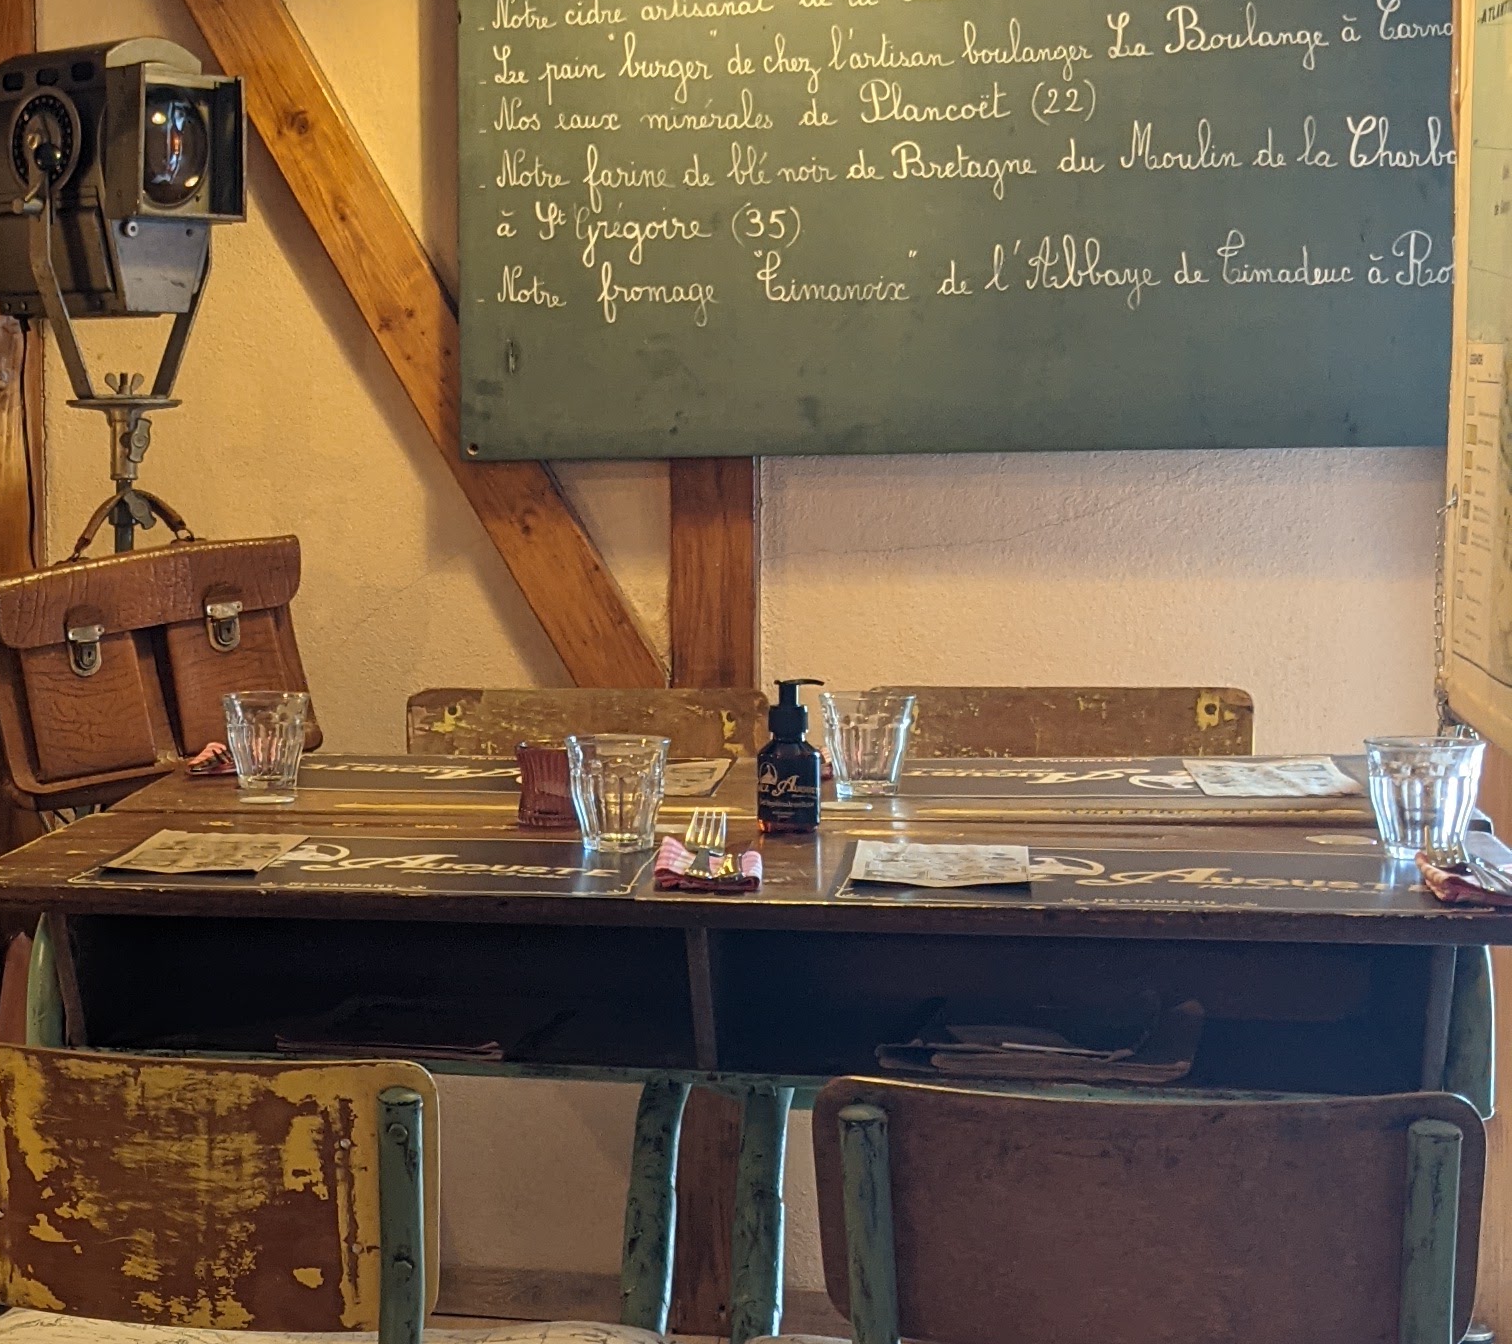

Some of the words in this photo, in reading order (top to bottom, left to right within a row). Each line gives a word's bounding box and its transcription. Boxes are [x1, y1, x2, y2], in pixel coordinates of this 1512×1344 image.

[493, 45, 529, 85] Le
[539, 58, 605, 105] pain
[728, 43, 755, 74] de
[764, 33, 821, 93] chez
[828, 25, 955, 70] l'artisan
[961, 18, 1093, 81] boulanger
[1107, 12, 1154, 59] La
[1165, 2, 1329, 70] Boulange
[1341, 15, 1361, 43] à
[494, 96, 541, 131] Nos
[555, 113, 621, 131] eaux
[640, 88, 773, 131] minérales
[799, 99, 838, 127] de
[859, 79, 1011, 123] Plancoët
[1031, 78, 1096, 126] (22)
[496, 149, 570, 188] Notre
[583, 143, 676, 214] farine
[683, 154, 716, 188] de
[727, 142, 772, 186] blé
[778, 157, 838, 183] noir
[846, 149, 885, 181] de
[891, 141, 1037, 201] Bretagne
[1057, 138, 1106, 174] du
[1120, 118, 1246, 170] Moulin
[1252, 127, 1287, 169] de
[1296, 115, 1339, 168] la
[496, 209, 517, 238] à
[534, 201, 567, 241] St
[573, 201, 713, 268] Grégoire
[731, 202, 802, 249] (35)
[497, 264, 567, 307] Notre
[598, 261, 719, 328] fromage
[937, 260, 973, 296] de
[984, 234, 1161, 310] l'Abbaye
[1174, 251, 1209, 284] de
[1368, 255, 1389, 285] à
[1392, 229, 1455, 288] Ro
